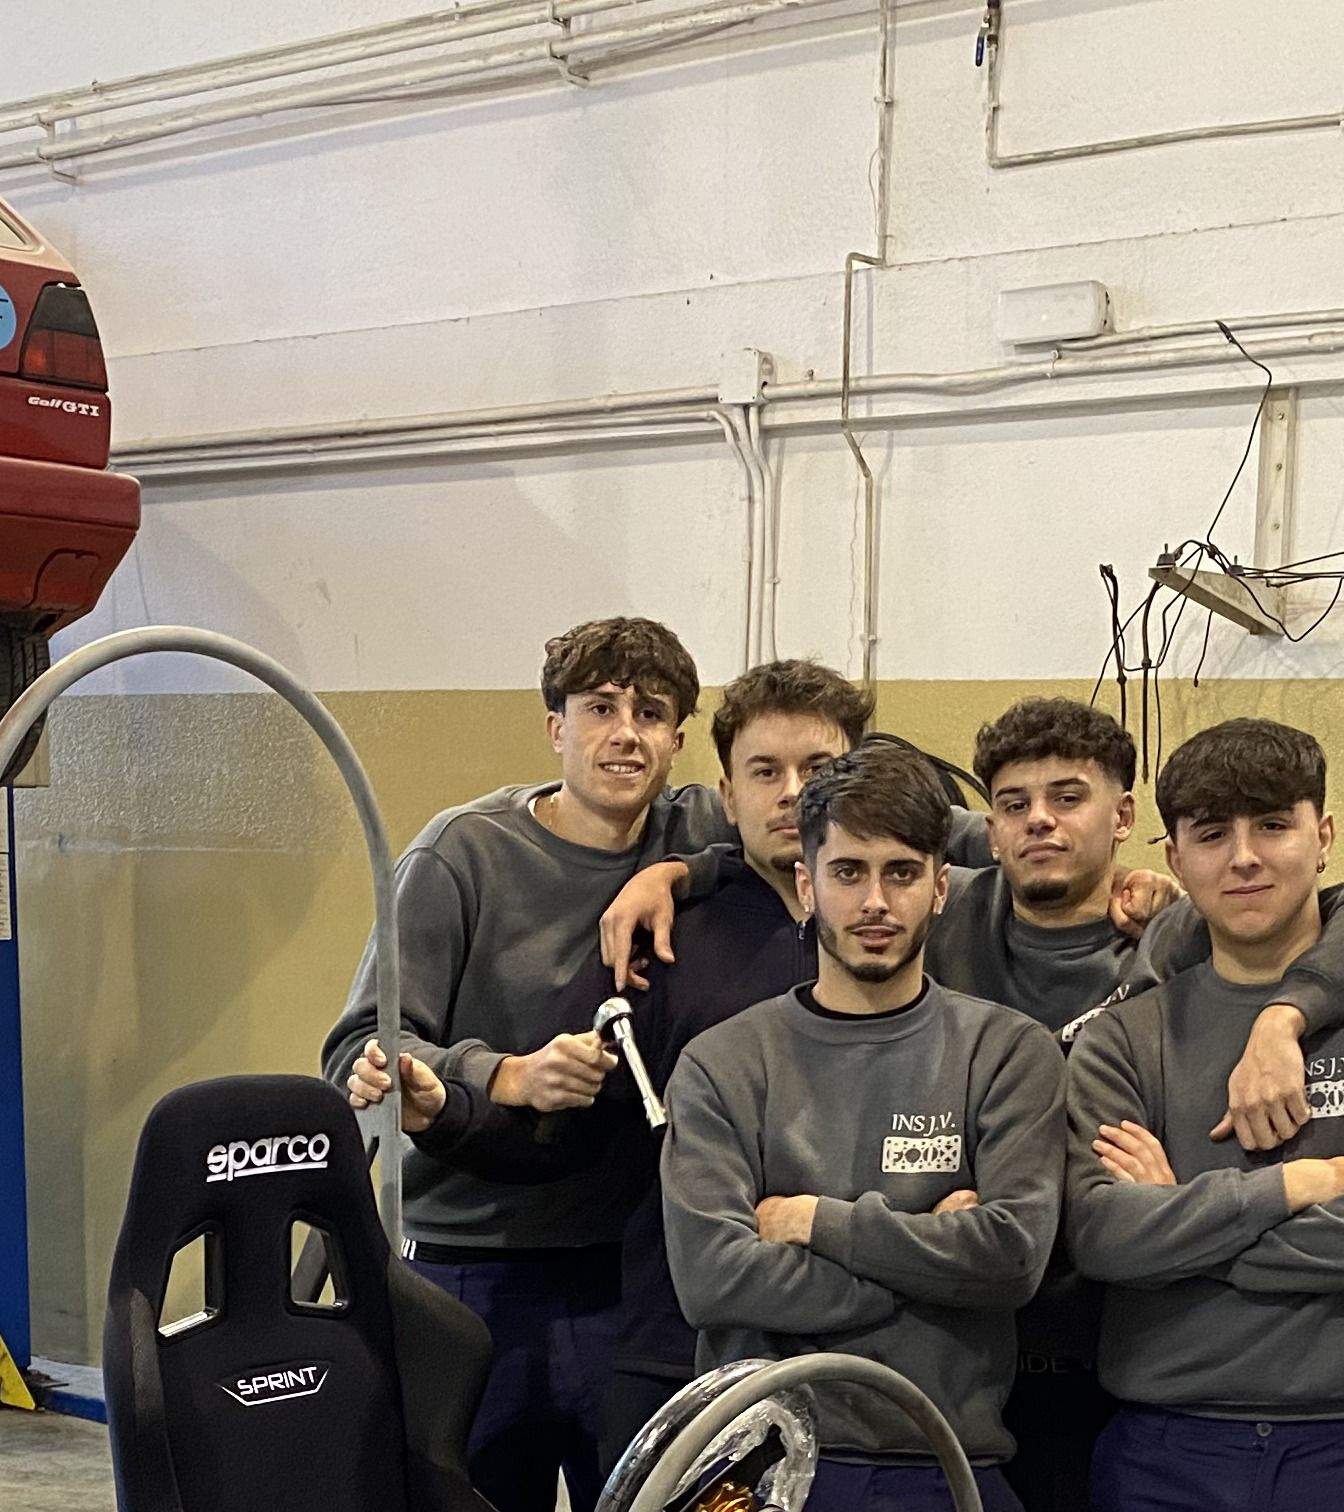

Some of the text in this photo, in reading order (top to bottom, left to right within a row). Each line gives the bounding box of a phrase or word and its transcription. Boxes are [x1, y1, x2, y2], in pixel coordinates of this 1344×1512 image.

[62, 402, 101, 417] GTI
[1305, 1058, 1326, 1077] NS
[891, 1111, 956, 1137] INS J.V.
[207, 1132, 331, 1183] sparco
[237, 1366, 318, 1396] SPRINT
